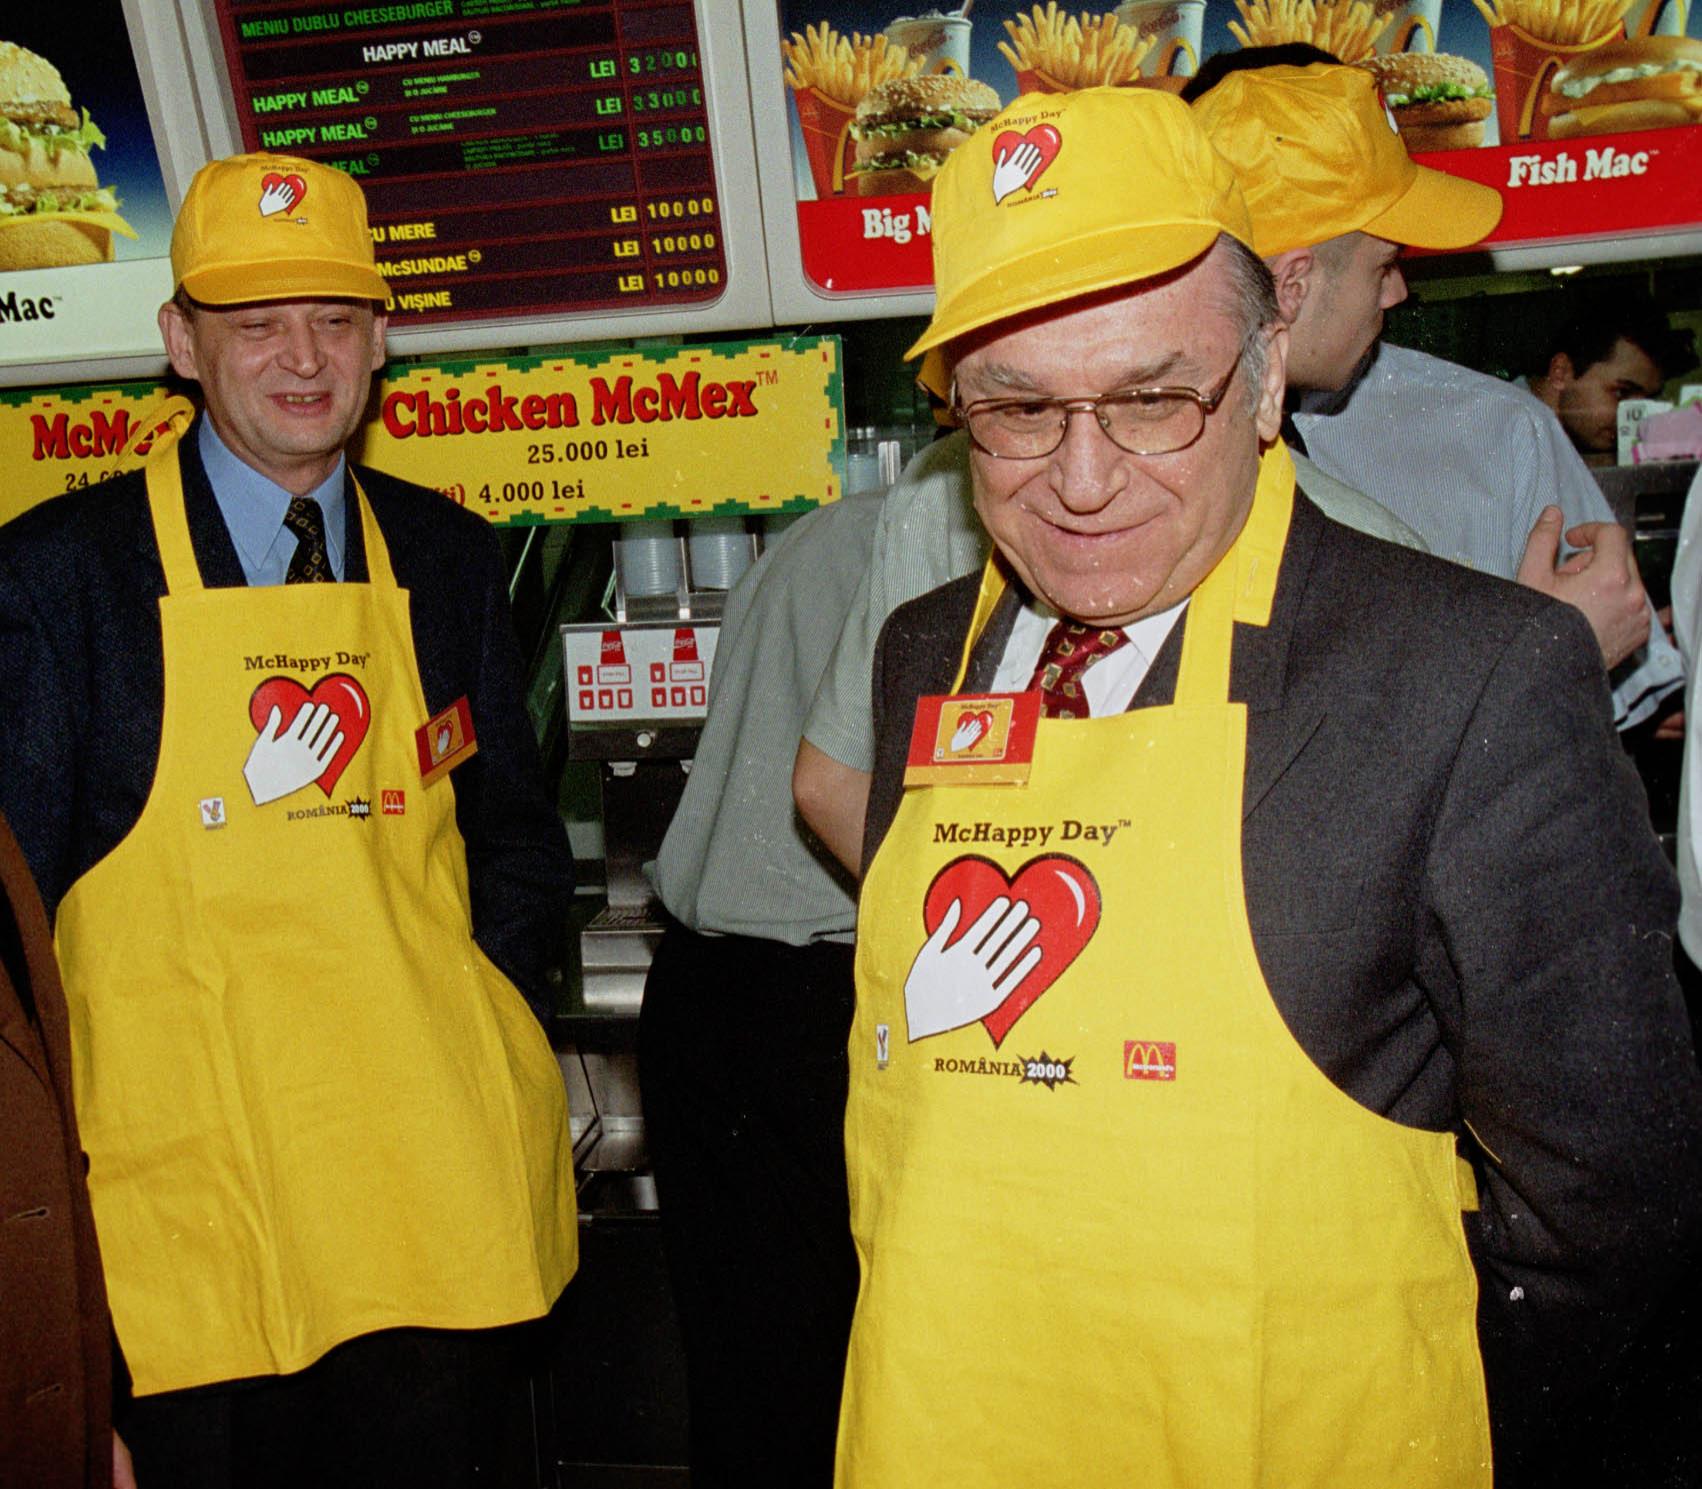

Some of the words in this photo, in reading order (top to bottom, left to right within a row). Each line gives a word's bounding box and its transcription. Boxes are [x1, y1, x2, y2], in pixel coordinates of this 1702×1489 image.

[242, 18, 289, 37] MENIU
[293, 13, 340, 33] DUBLU
[344, 0, 453, 27] CHEESEBURGER
[362, 42, 418, 63] HAPPY
[423, 38, 471, 57] MEAL
[589, 60, 616, 78] LEI
[252, 93, 309, 113] HAPPY
[312, 87, 360, 106] MEAL
[596, 97, 622, 115] LEI
[263, 127, 318, 148] HAPPY
[320, 123, 368, 142] MEAL
[598, 133, 624, 152] LEI
[638, 126, 705, 148] 35000
[1507, 152, 1578, 188] Fish
[1583, 147, 1648, 181] Mac
[389, 222, 436, 241] MERE
[611, 206, 637, 223] LEI
[647, 198, 713, 219] 10000
[862, 207, 912, 244] Big
[376, 255, 468, 276] McSUNDAE
[613, 240, 640, 257] LEI
[652, 233, 715, 254] 10000
[619, 275, 644, 292] LEI
[655, 269, 719, 288] 10000
[382, 385, 579, 440] Chicken
[589, 371, 758, 427] McMex
[527, 441, 608, 465] 25.000
[615, 438, 649, 460] lei
[479, 481, 544, 503] 4.000
[552, 480, 585, 499] lei
[244, 653, 331, 672] McHappy
[336, 652, 367, 671] Day
[933, 822, 1054, 848] McHappy
[1060, 821, 1118, 847] Day
[934, 1058, 1023, 1077] ROMÂNIA
[1026, 1064, 1066, 1079] 2000
